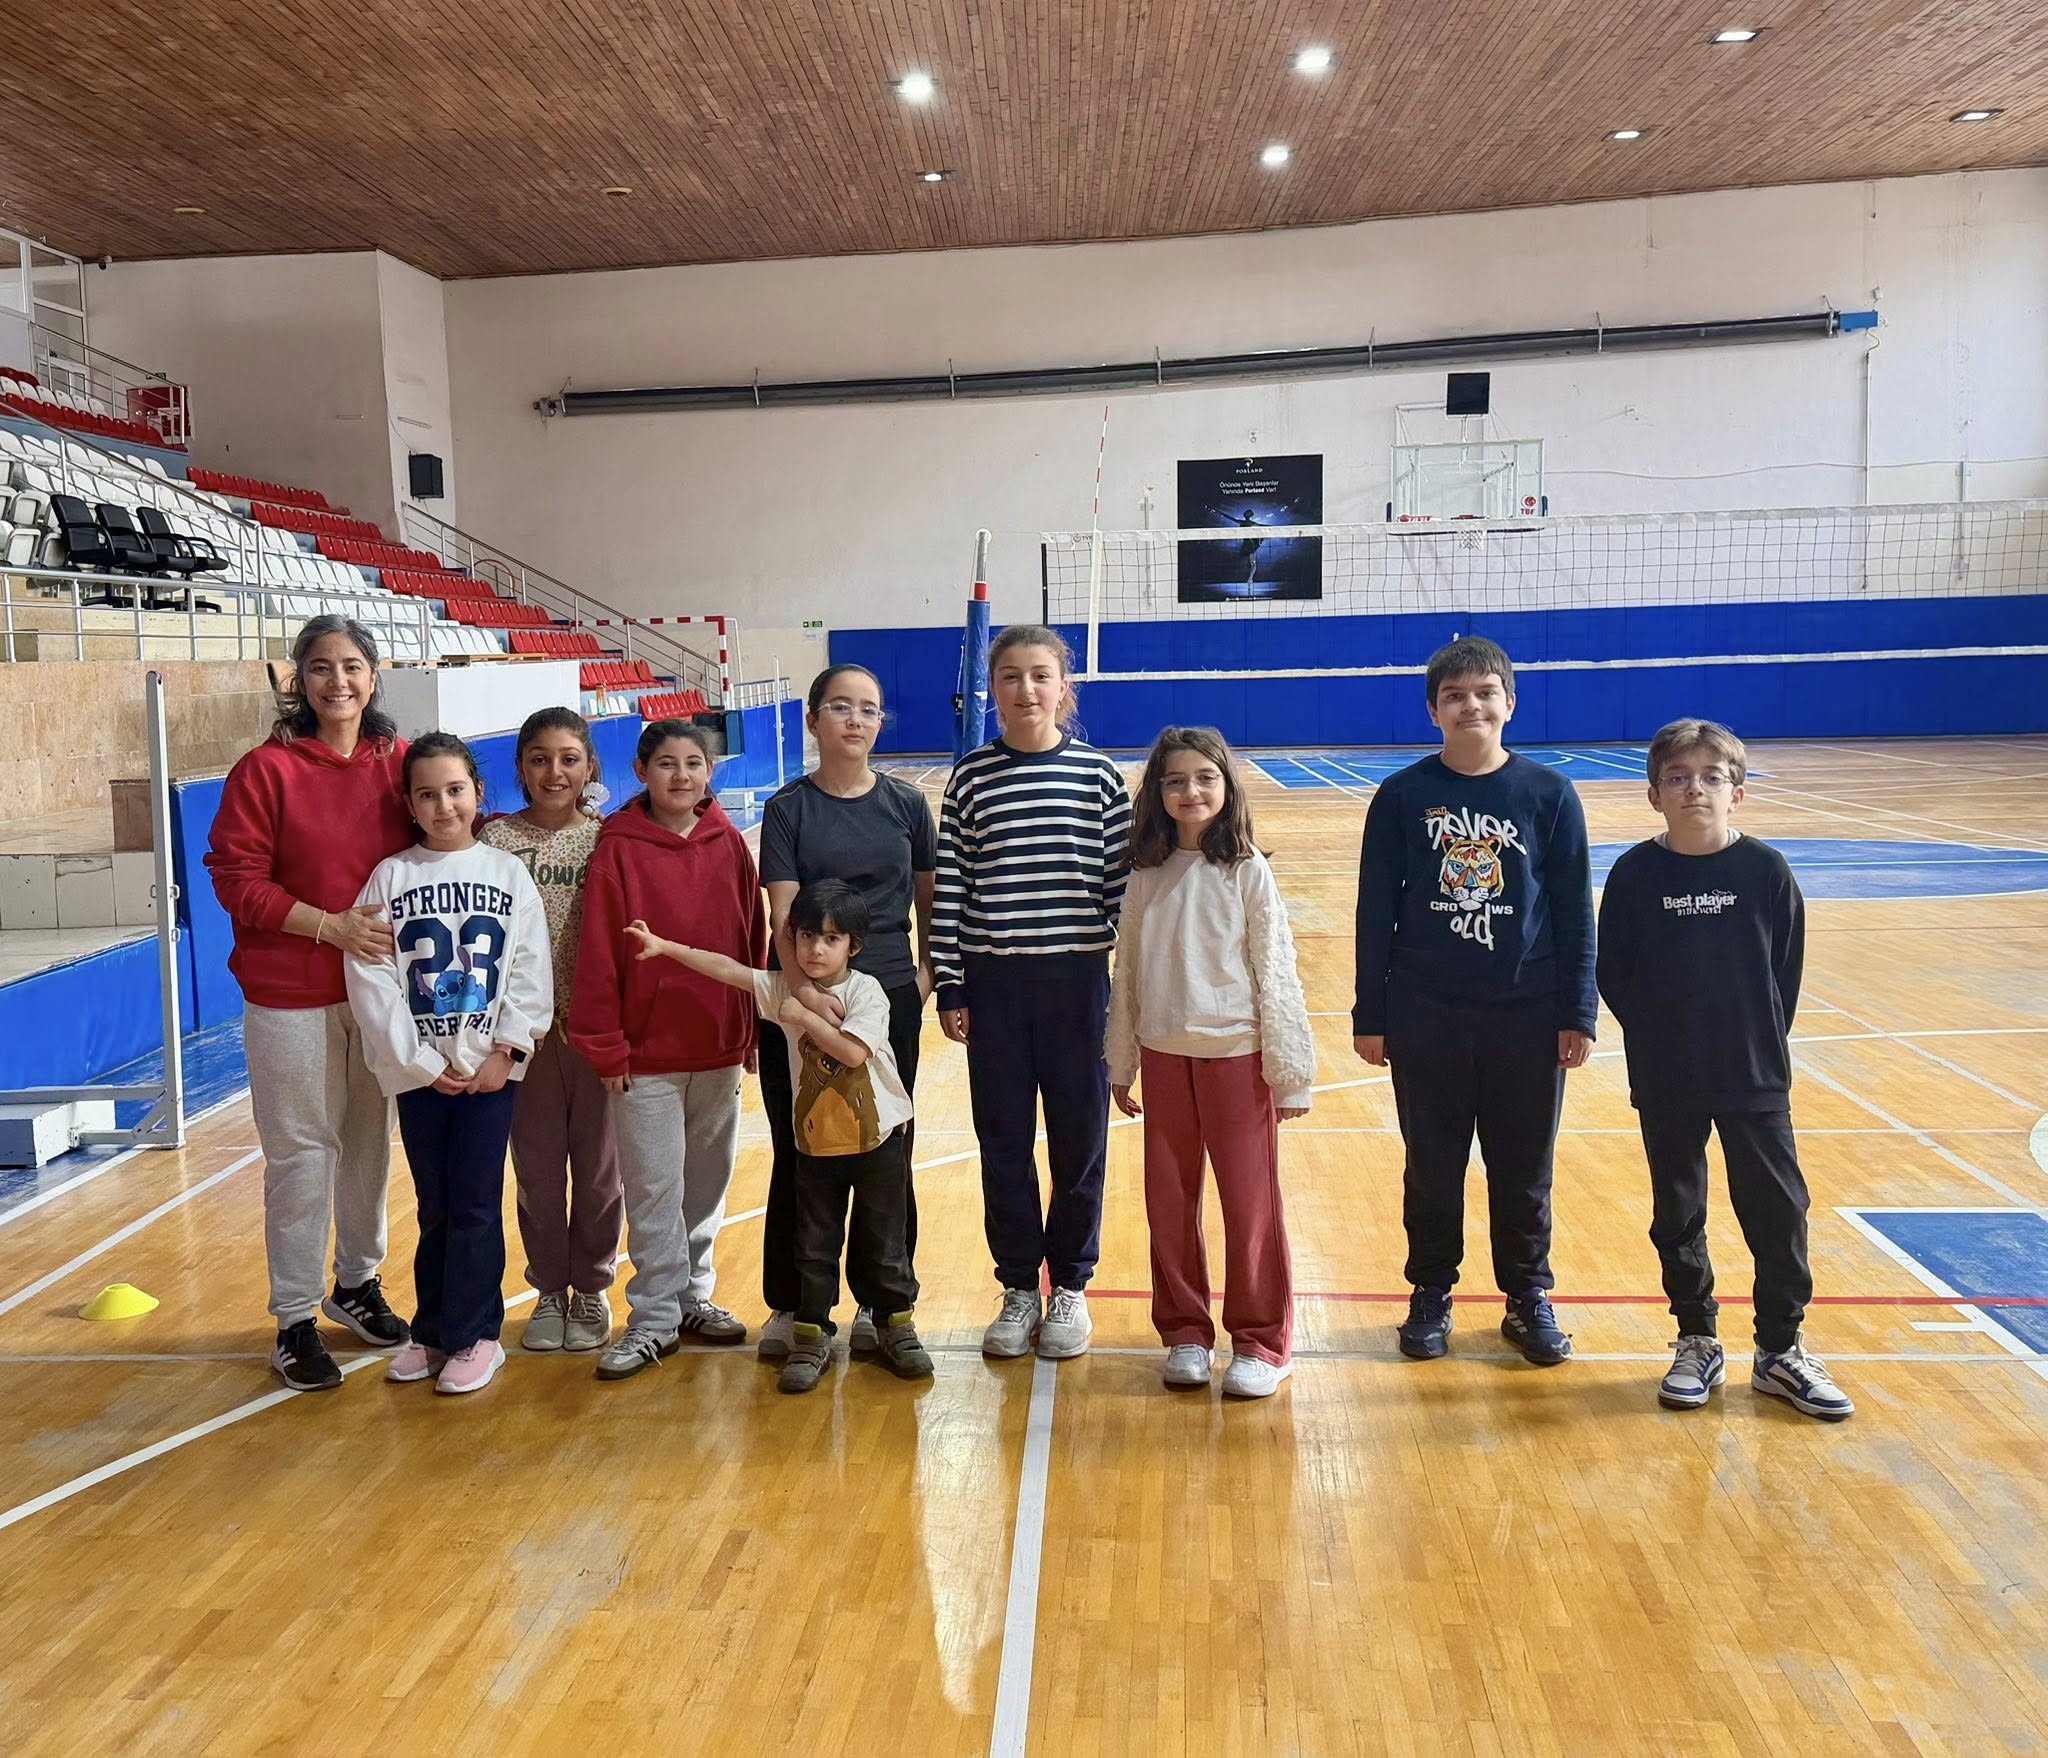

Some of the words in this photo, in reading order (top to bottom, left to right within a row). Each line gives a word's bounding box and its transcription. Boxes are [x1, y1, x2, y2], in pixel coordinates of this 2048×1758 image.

[390, 882, 513, 921] STRONGER
[1430, 900, 1459, 912] GRO
[1491, 905, 1514, 915] WS
[1662, 894, 1692, 910] Best
[1695, 892, 1737, 909] player
[396, 914, 506, 1015] 23
